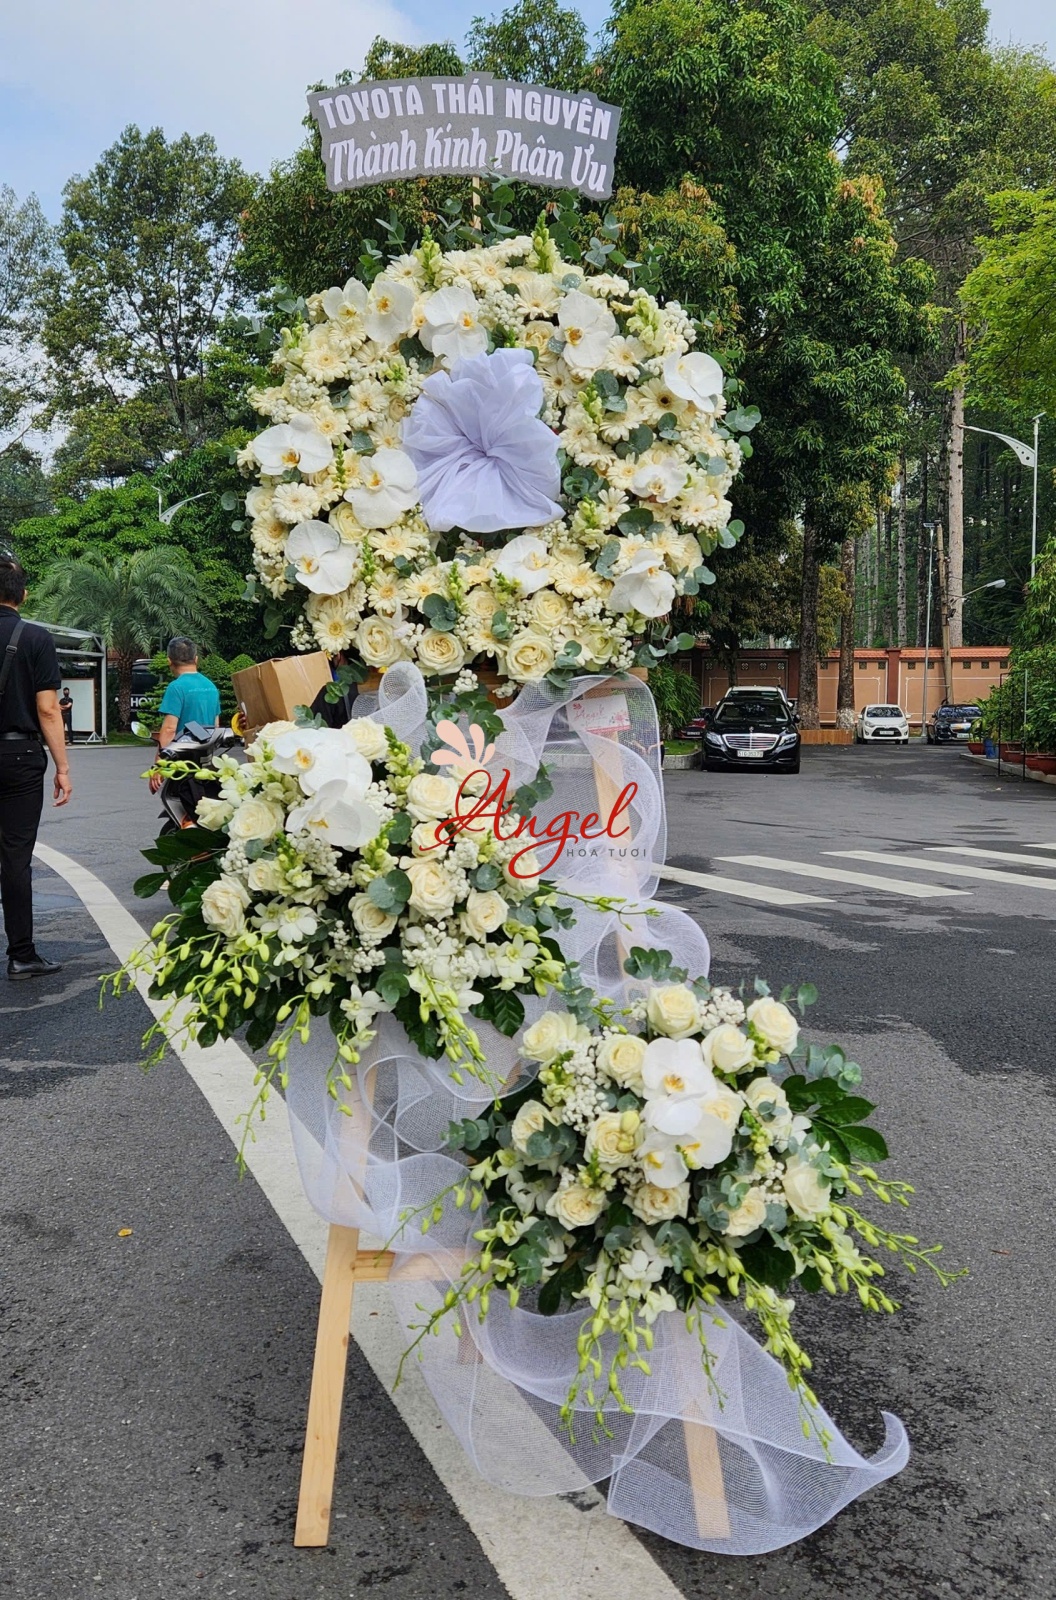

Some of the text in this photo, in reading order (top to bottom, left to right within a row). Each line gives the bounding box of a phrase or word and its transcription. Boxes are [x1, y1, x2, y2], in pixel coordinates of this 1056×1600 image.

[318, 78, 612, 140] TOYOTA THÁI NGUYÊN
[329, 123, 607, 192] Thành Kính Phân Ưu
